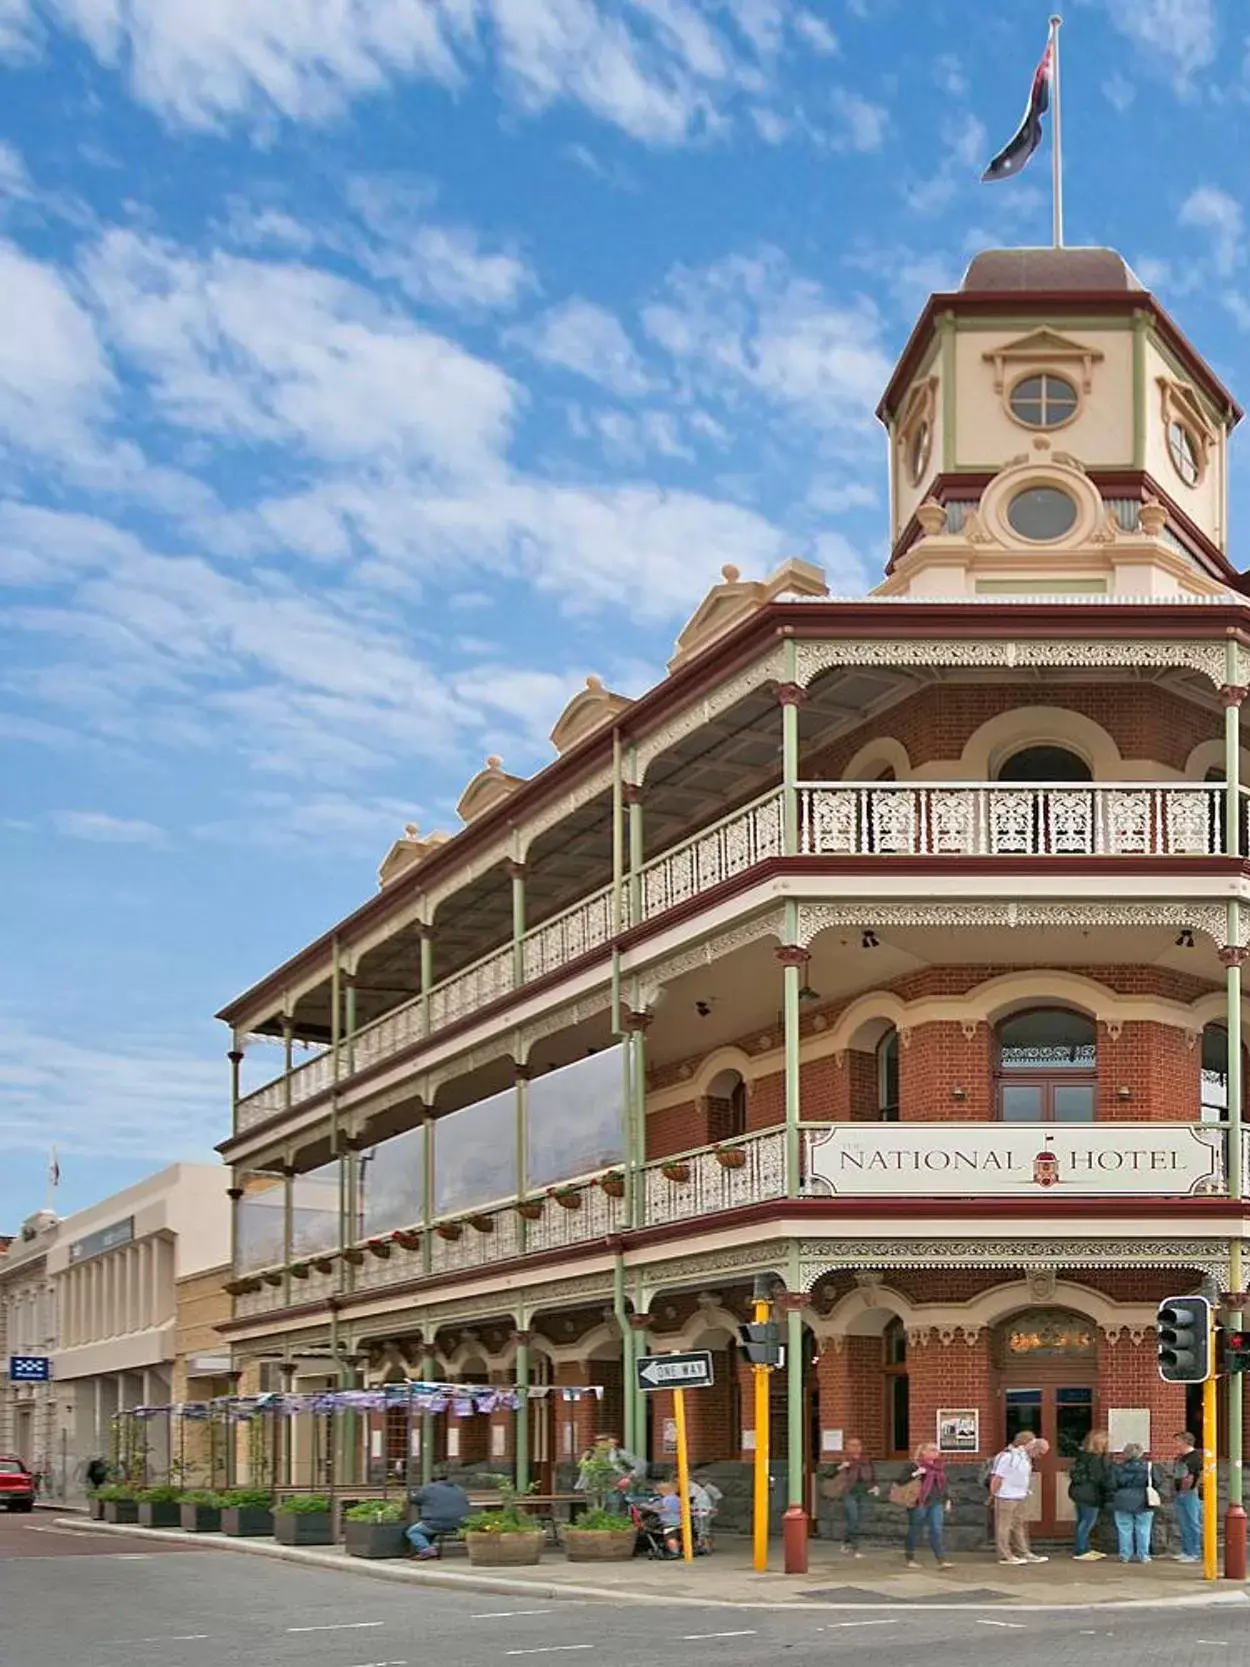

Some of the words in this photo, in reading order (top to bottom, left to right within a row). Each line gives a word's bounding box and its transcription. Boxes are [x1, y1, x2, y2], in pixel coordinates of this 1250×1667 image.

[840, 1150, 1022, 1171] NATIONAL
[1070, 1151, 1188, 1170] HOTEL
[656, 1365, 677, 1378] ONE
